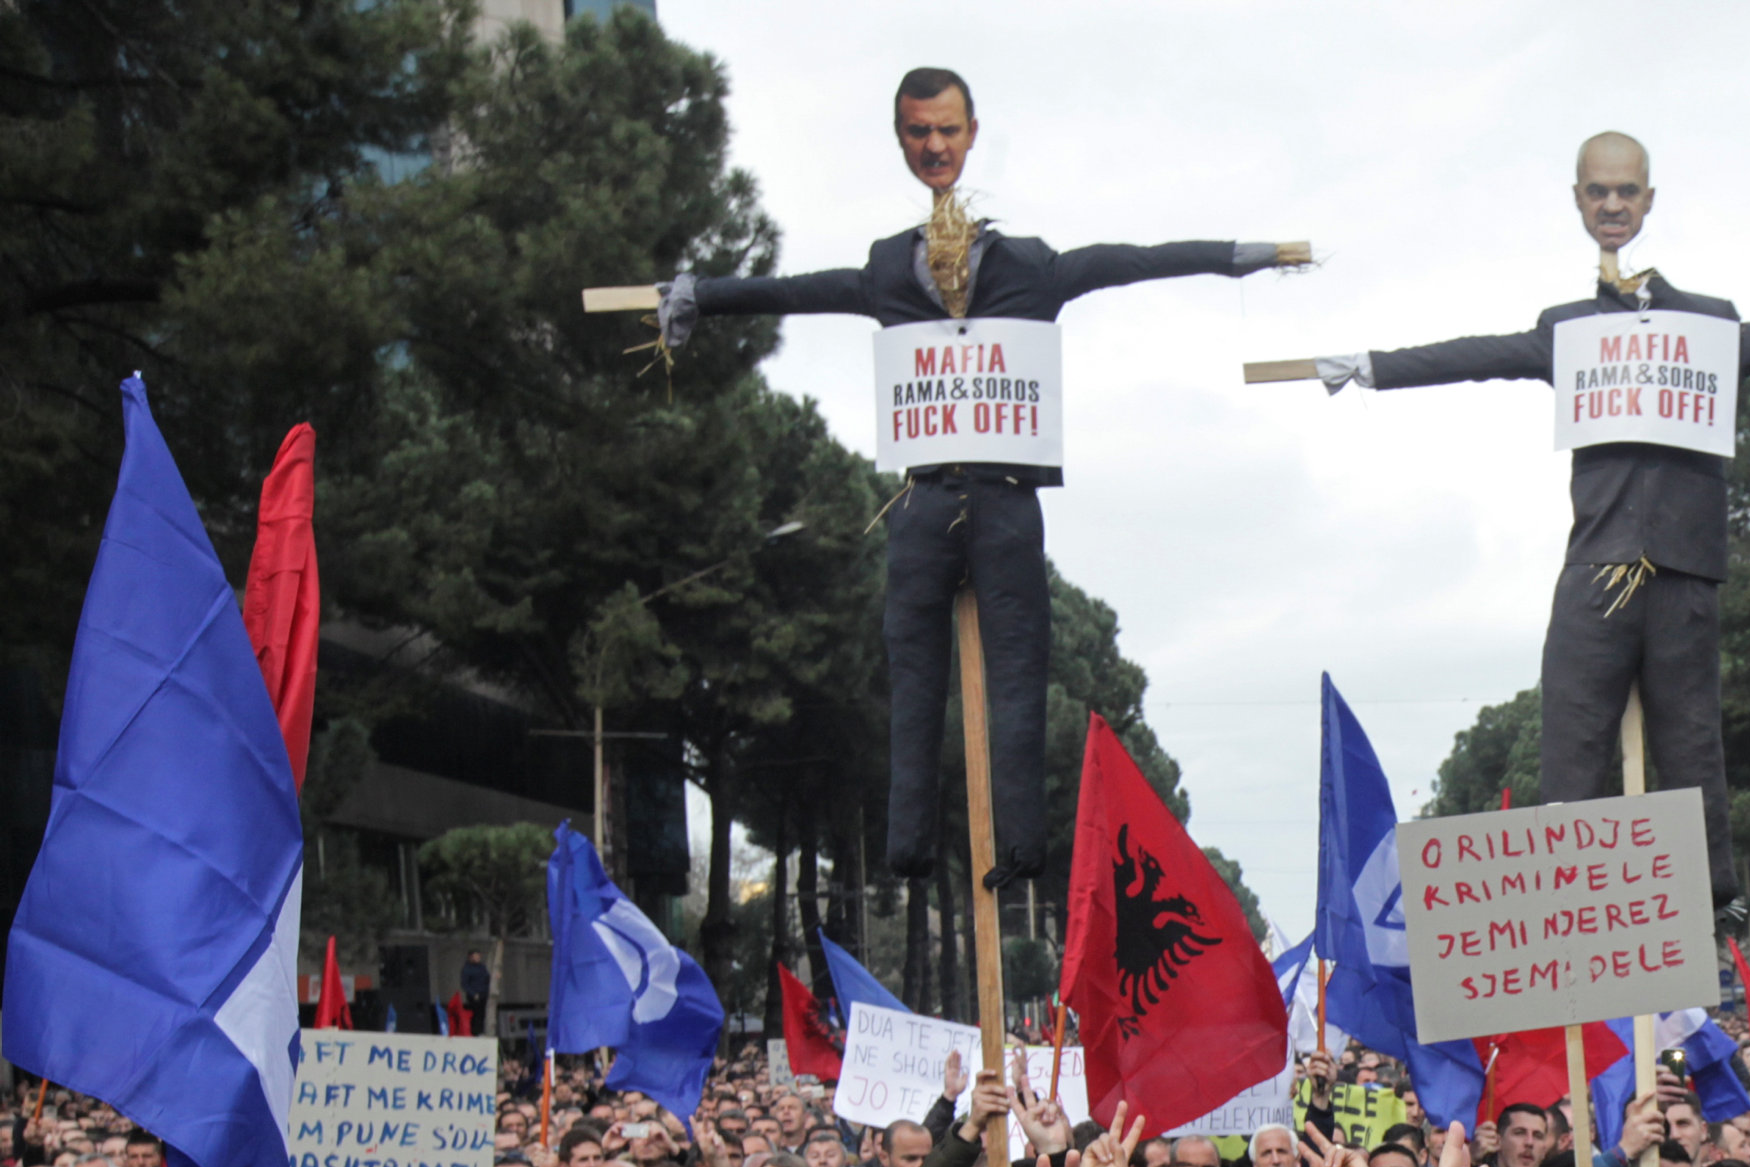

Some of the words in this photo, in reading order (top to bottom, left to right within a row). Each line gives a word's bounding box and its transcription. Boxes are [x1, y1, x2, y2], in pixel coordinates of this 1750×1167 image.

[915, 343, 1006, 377] MAFIA
[1600, 334, 1689, 364] MAFIA
[894, 377, 1040, 407] RAMA&SOROS
[1575, 363, 1718, 394] RAMA&SOROS
[893, 404, 957, 442] FUCK
[974, 403, 1038, 436] OFF!
[1574, 388, 1642, 423] FUCK
[1658, 389, 1715, 426] OFF!
[1423, 854, 1675, 911] KRIMINELE
[1589, 940, 1685, 983] DELE
[858, 1010, 894, 1041] DUA
[905, 1021, 932, 1050] TE
[368, 1044, 411, 1072] ME
[853, 1044, 880, 1069] NE
[366, 1086, 406, 1110] ME
[416, 1088, 496, 1116] KRIME
[847, 1076, 889, 1111] JO
[335, 1120, 420, 1148] PUNE
